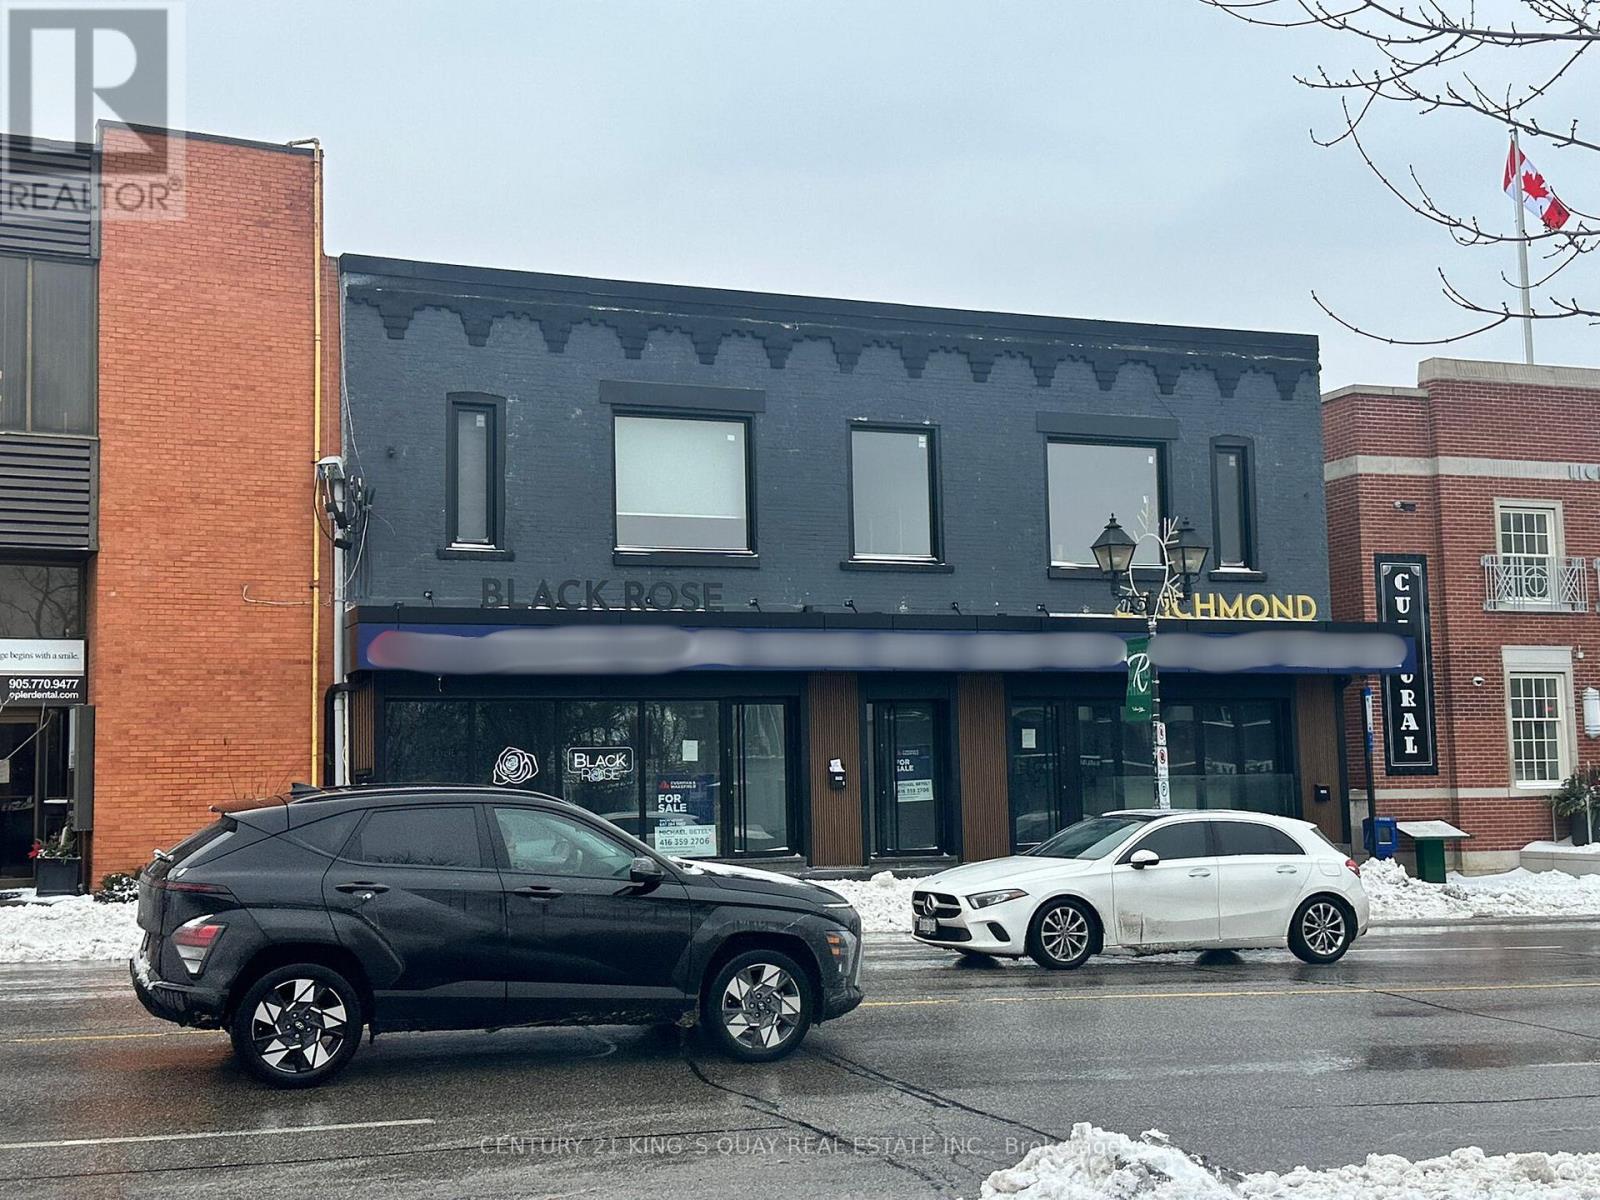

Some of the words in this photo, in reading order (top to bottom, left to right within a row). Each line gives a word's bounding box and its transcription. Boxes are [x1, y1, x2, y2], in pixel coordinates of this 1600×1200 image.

[482, 578, 610, 608] BLACK
[625, 580, 723, 612] ROSE
[10, 651, 34, 661] begins
[35, 652, 51, 660] with
[58, 652, 80, 660] smile.
[8, 679, 79, 689] 905.770.9477
[574, 753, 627, 768] BLACK
[581, 767, 620, 782] ROSE
[658, 794, 681, 803] FOR
[658, 803, 687, 813] SALE
[691, 837, 710, 845] 2706
